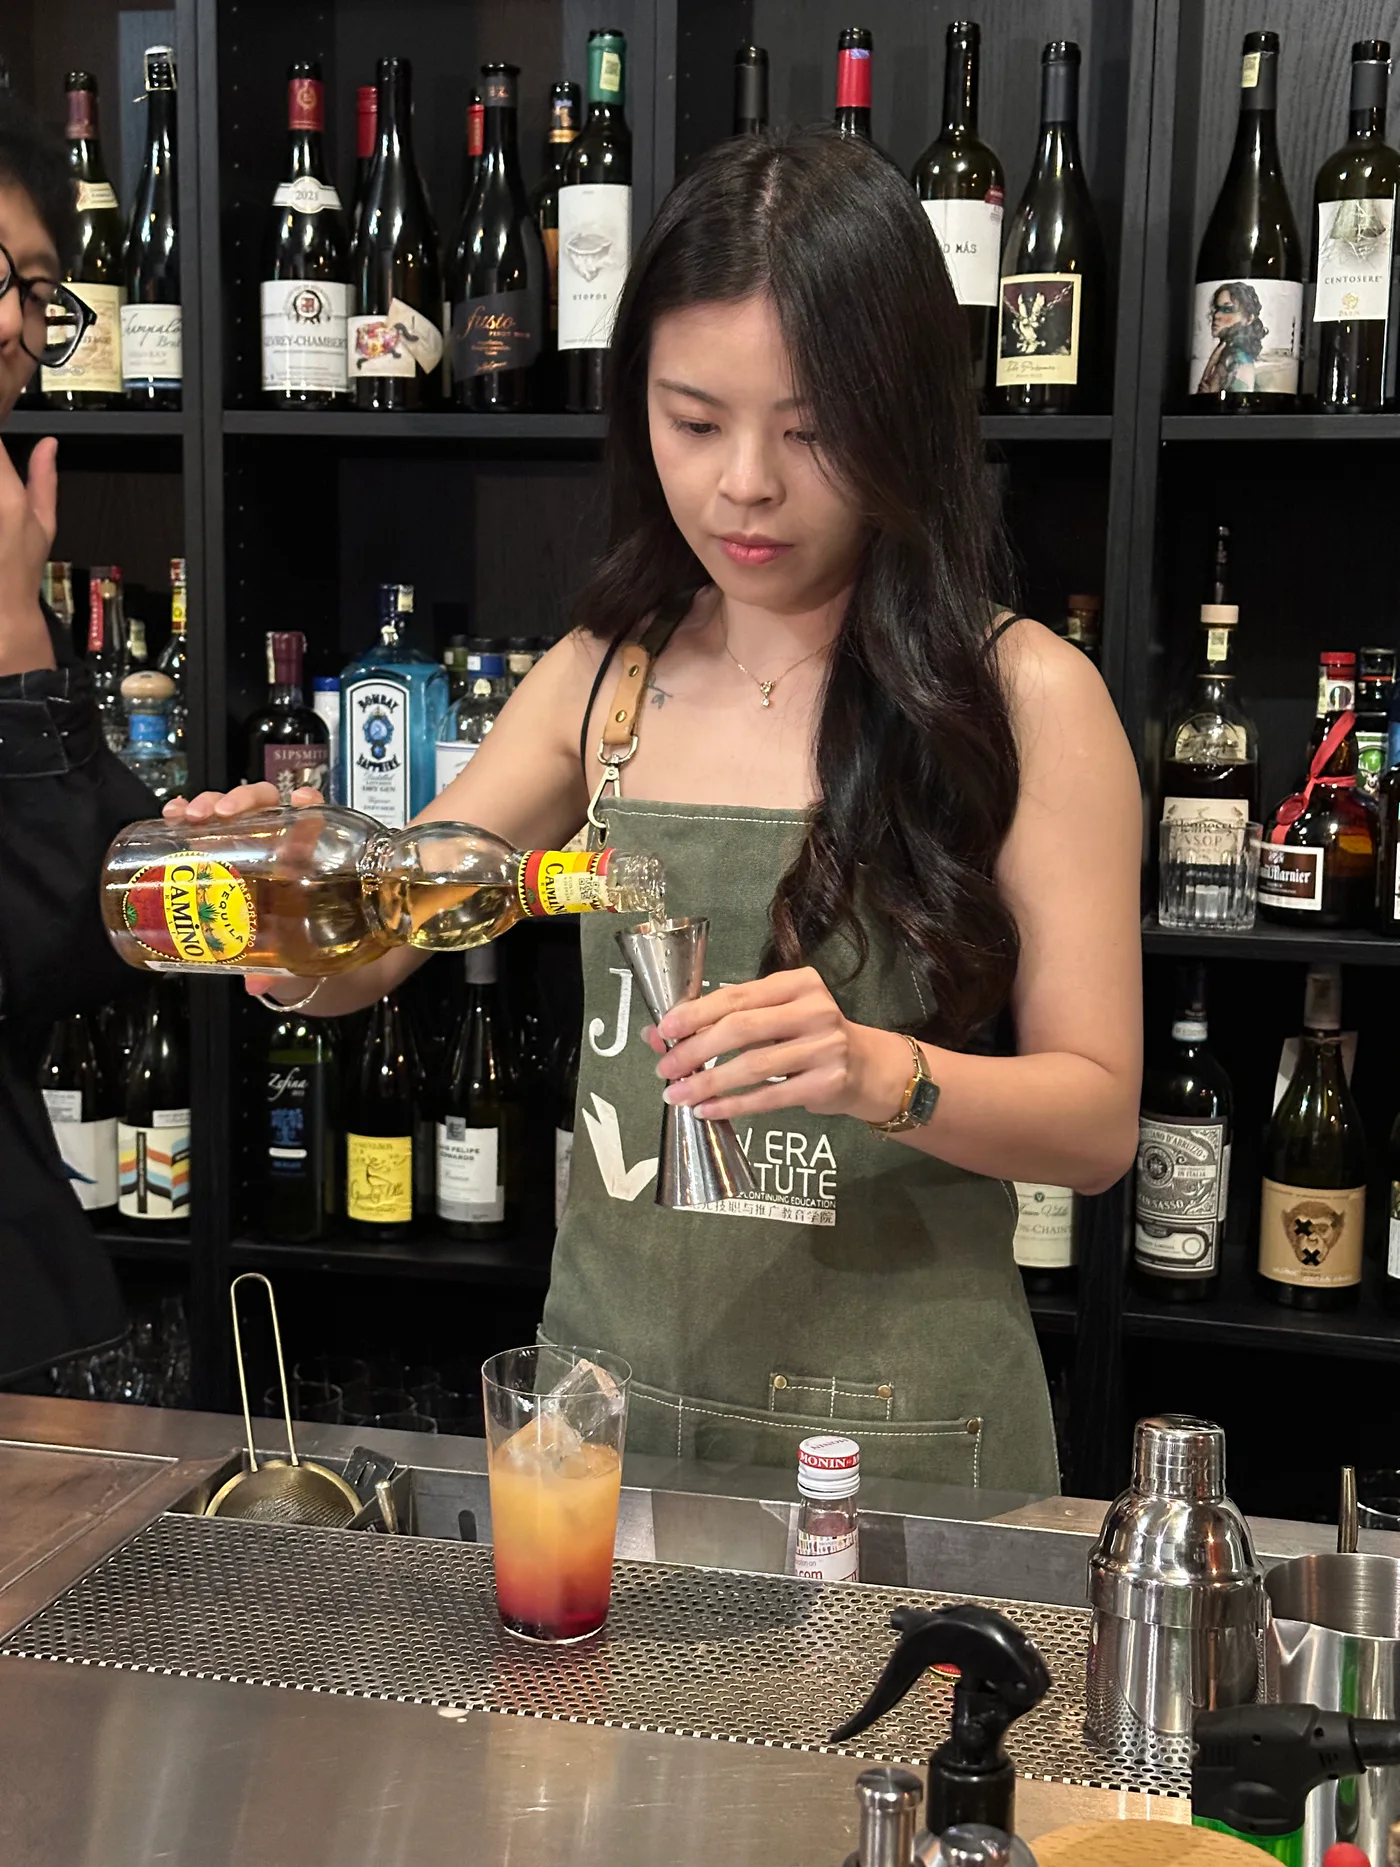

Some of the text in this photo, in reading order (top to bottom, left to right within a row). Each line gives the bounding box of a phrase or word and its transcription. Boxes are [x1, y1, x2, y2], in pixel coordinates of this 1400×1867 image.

[955, 241, 977, 254] MÁS
[1324, 275, 1381, 285] CENTOSERE
[357, 694, 399, 714] BOMBAY
[356, 753, 402, 773] SAPPHIRE
[170, 864, 205, 957] CAMINO
[218, 883, 243, 943] TEQUILA
[237, 877, 258, 947] IMPORTADO
[451, 1145, 480, 1154] FELIPE
[765, 1130, 837, 1169] ERA
[752, 1162, 837, 1200] TUTE
[791, 1197, 836, 1209] EDUCATION
[1153, 1199, 1184, 1209] SASSO
[799, 1451, 846, 1468] MONIN
